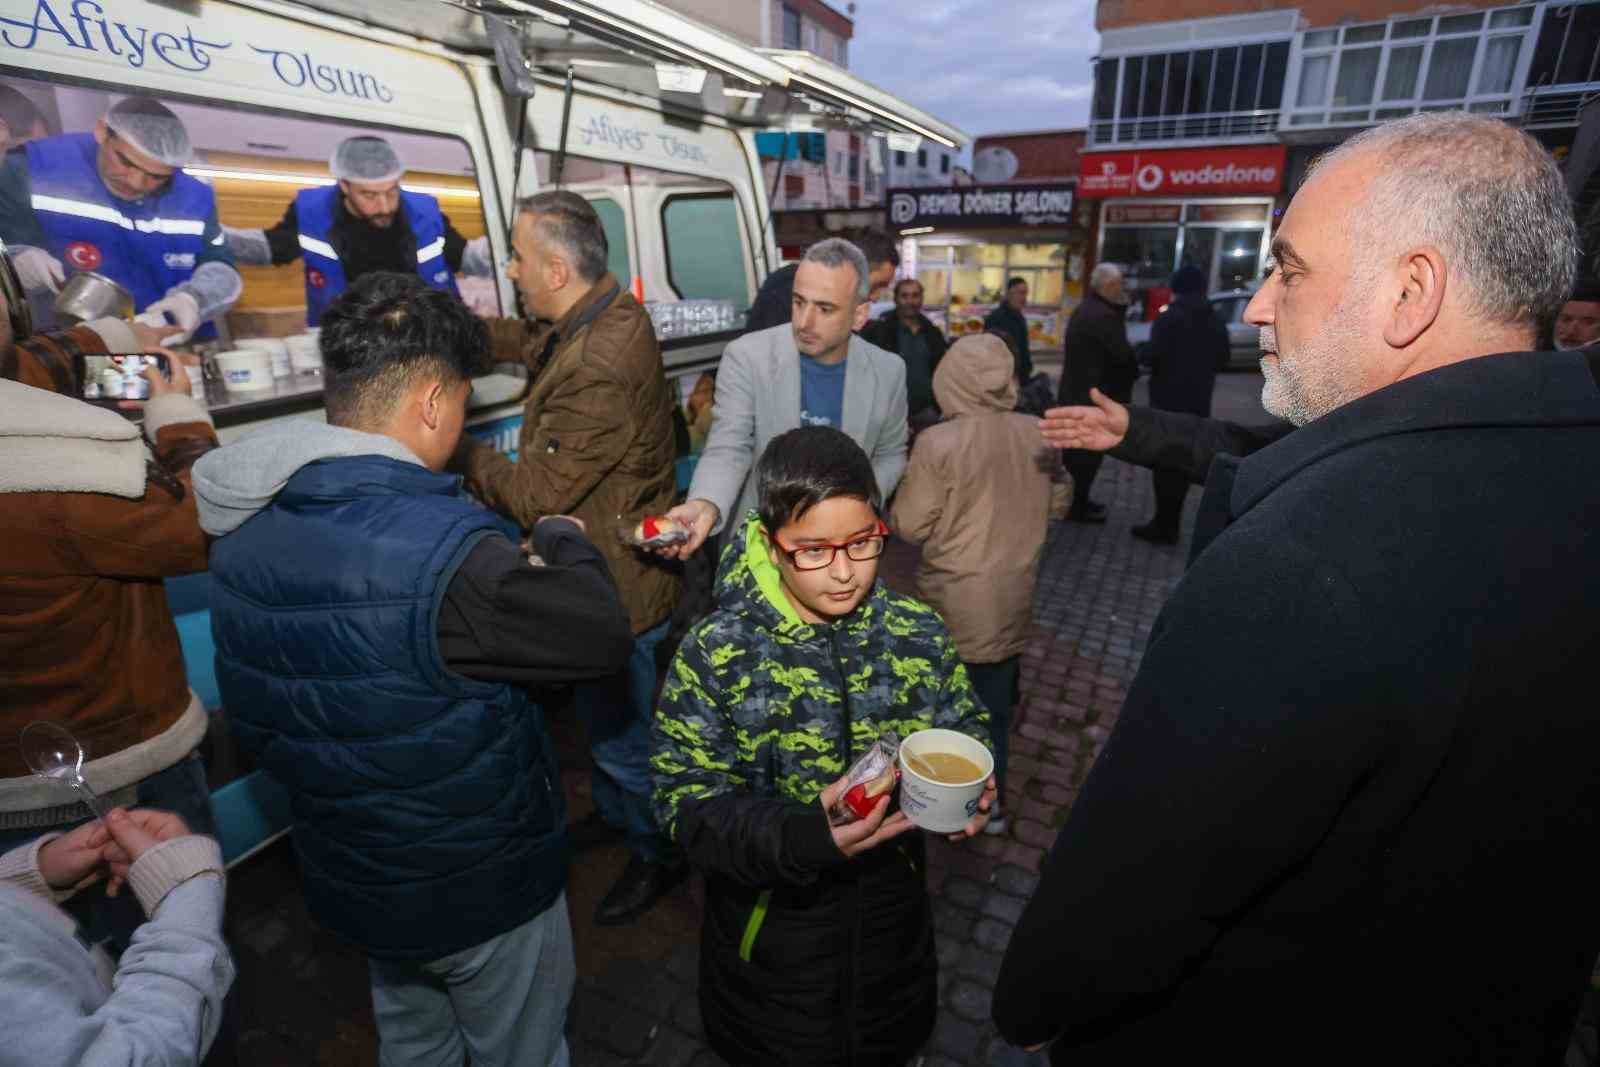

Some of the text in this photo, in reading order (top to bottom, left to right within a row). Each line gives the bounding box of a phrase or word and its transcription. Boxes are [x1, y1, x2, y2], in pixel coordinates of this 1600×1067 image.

[0, 0, 394, 103] Afiyet Olsun
[1169, 161, 1277, 185] vodafone
